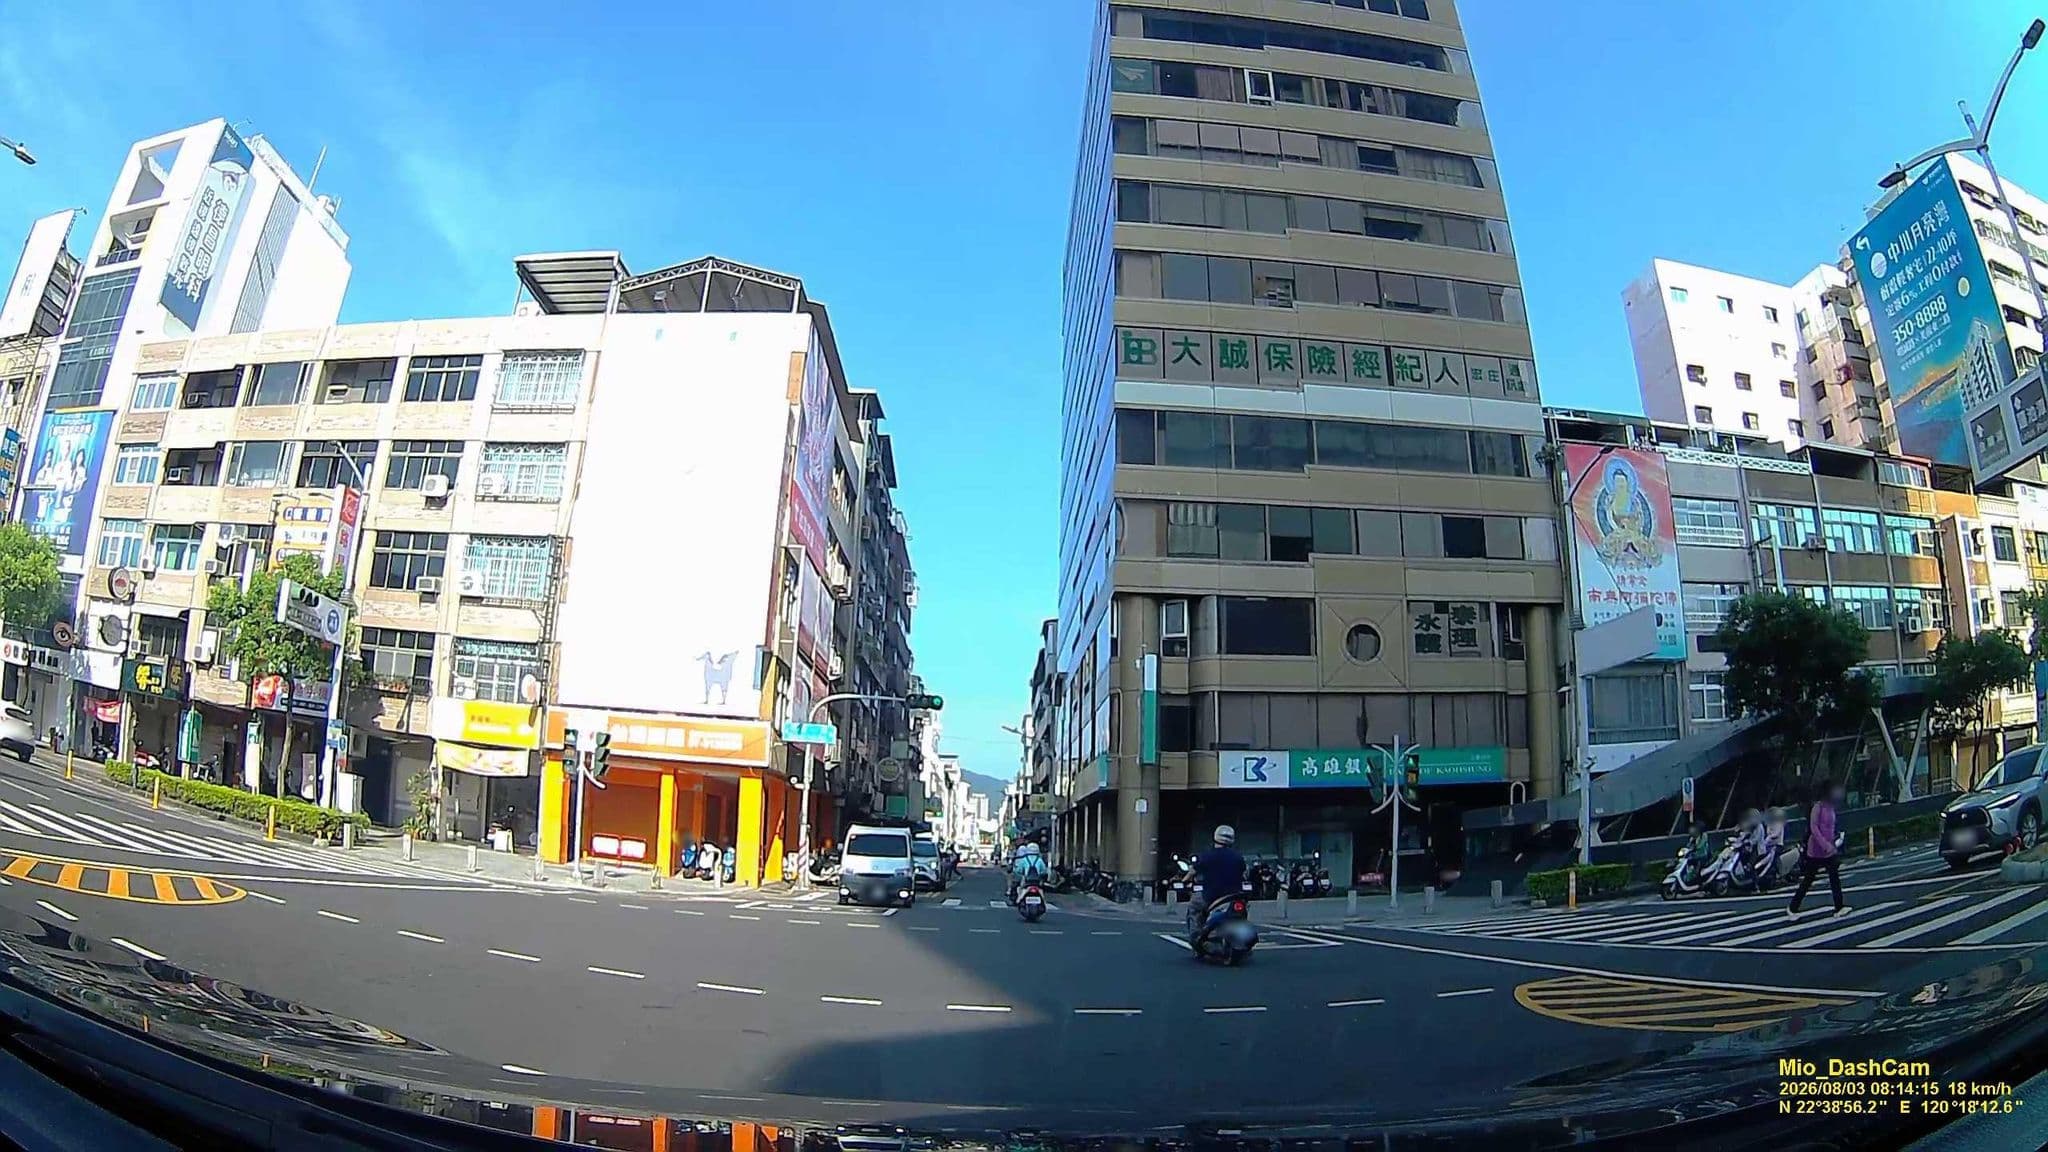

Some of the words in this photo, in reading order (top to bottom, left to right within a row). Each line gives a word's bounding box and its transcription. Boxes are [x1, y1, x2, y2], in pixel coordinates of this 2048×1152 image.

[1887, 199, 1950, 263] 中川月亮灣
[1891, 295, 1948, 345] 350-8888
[1171, 335, 1459, 386] 大誠保險經紀人
[1302, 756, 1371, 777] 高雄銀
[1436, 765, 1492, 775] KAOHSIUNG
